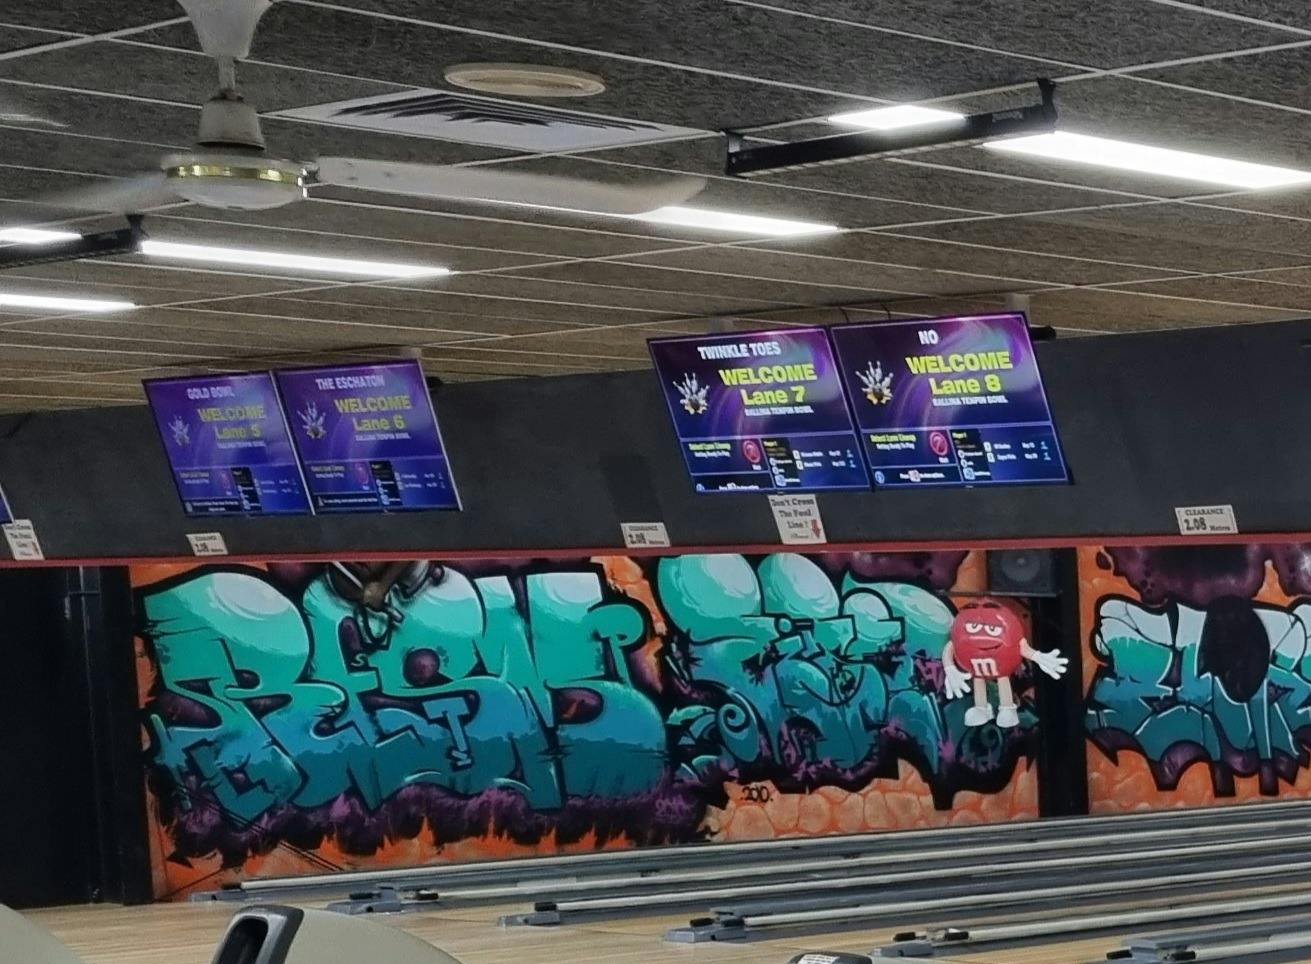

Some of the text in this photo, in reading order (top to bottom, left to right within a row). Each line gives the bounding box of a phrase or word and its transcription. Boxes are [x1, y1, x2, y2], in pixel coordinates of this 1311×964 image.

[918, 330, 938, 345] NO
[698, 342, 781, 360] TWINKLE TOES
[905, 351, 1013, 374] WELCOME
[316, 375, 384, 390] THE ESCHATON
[719, 363, 817, 386] WELCOME
[929, 375, 1001, 396] Lane 8
[335, 395, 412, 412] WELCOME
[740, 386, 806, 406] Lane 7
[198, 406, 266, 421] WELCOME
[354, 416, 405, 431] Lane 6
